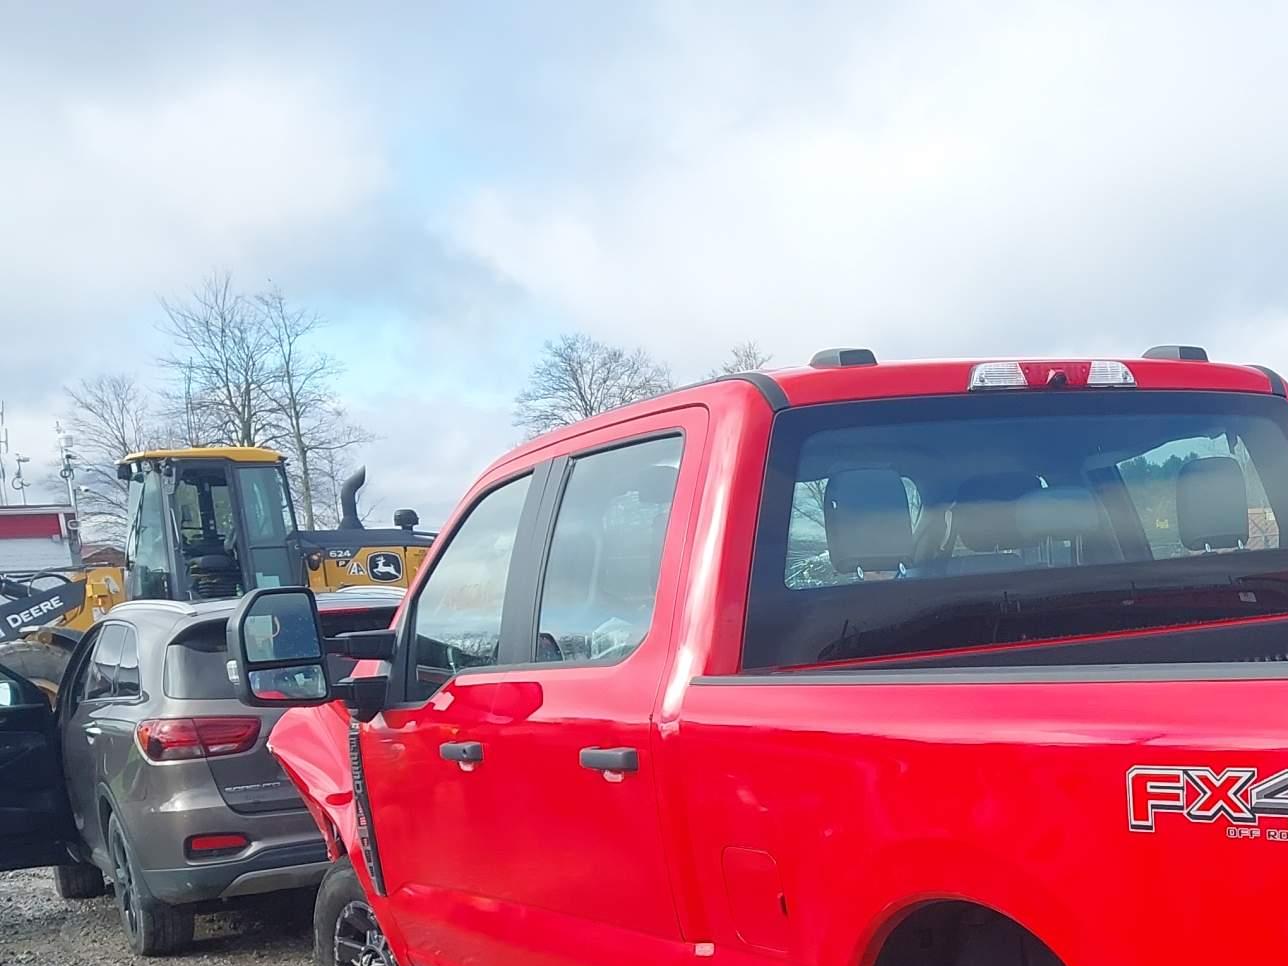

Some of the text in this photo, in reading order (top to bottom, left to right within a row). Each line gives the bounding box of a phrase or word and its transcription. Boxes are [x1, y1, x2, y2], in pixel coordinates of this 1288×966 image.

[329, 549, 351, 558] 624
[6, 595, 64, 629] DEERE
[1226, 826, 1261, 839] OFF
